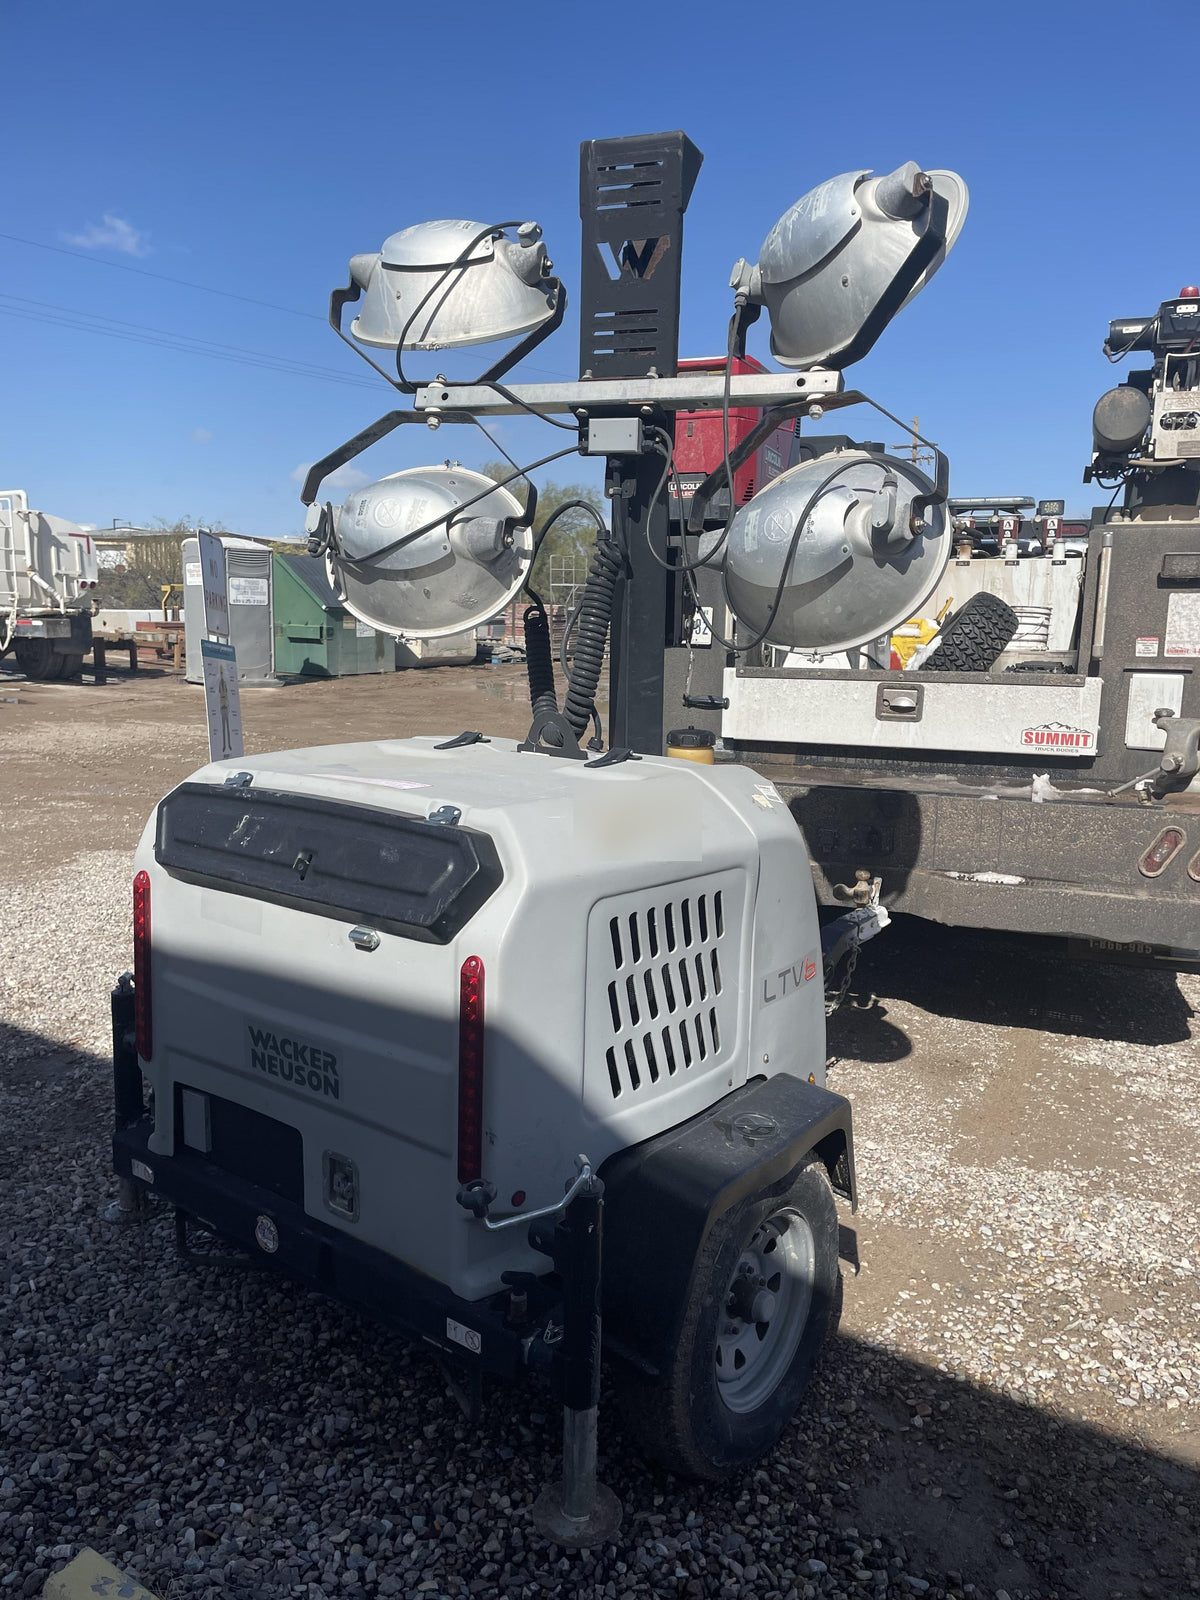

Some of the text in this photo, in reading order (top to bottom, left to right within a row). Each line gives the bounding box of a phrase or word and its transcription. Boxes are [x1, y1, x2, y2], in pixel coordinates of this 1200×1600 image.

[205, 589, 227, 614] PARKING
[1023, 731, 1091, 747] SUMMIT
[247, 1025, 339, 1077] WACKER
[251, 1048, 340, 1100] NEUSON
